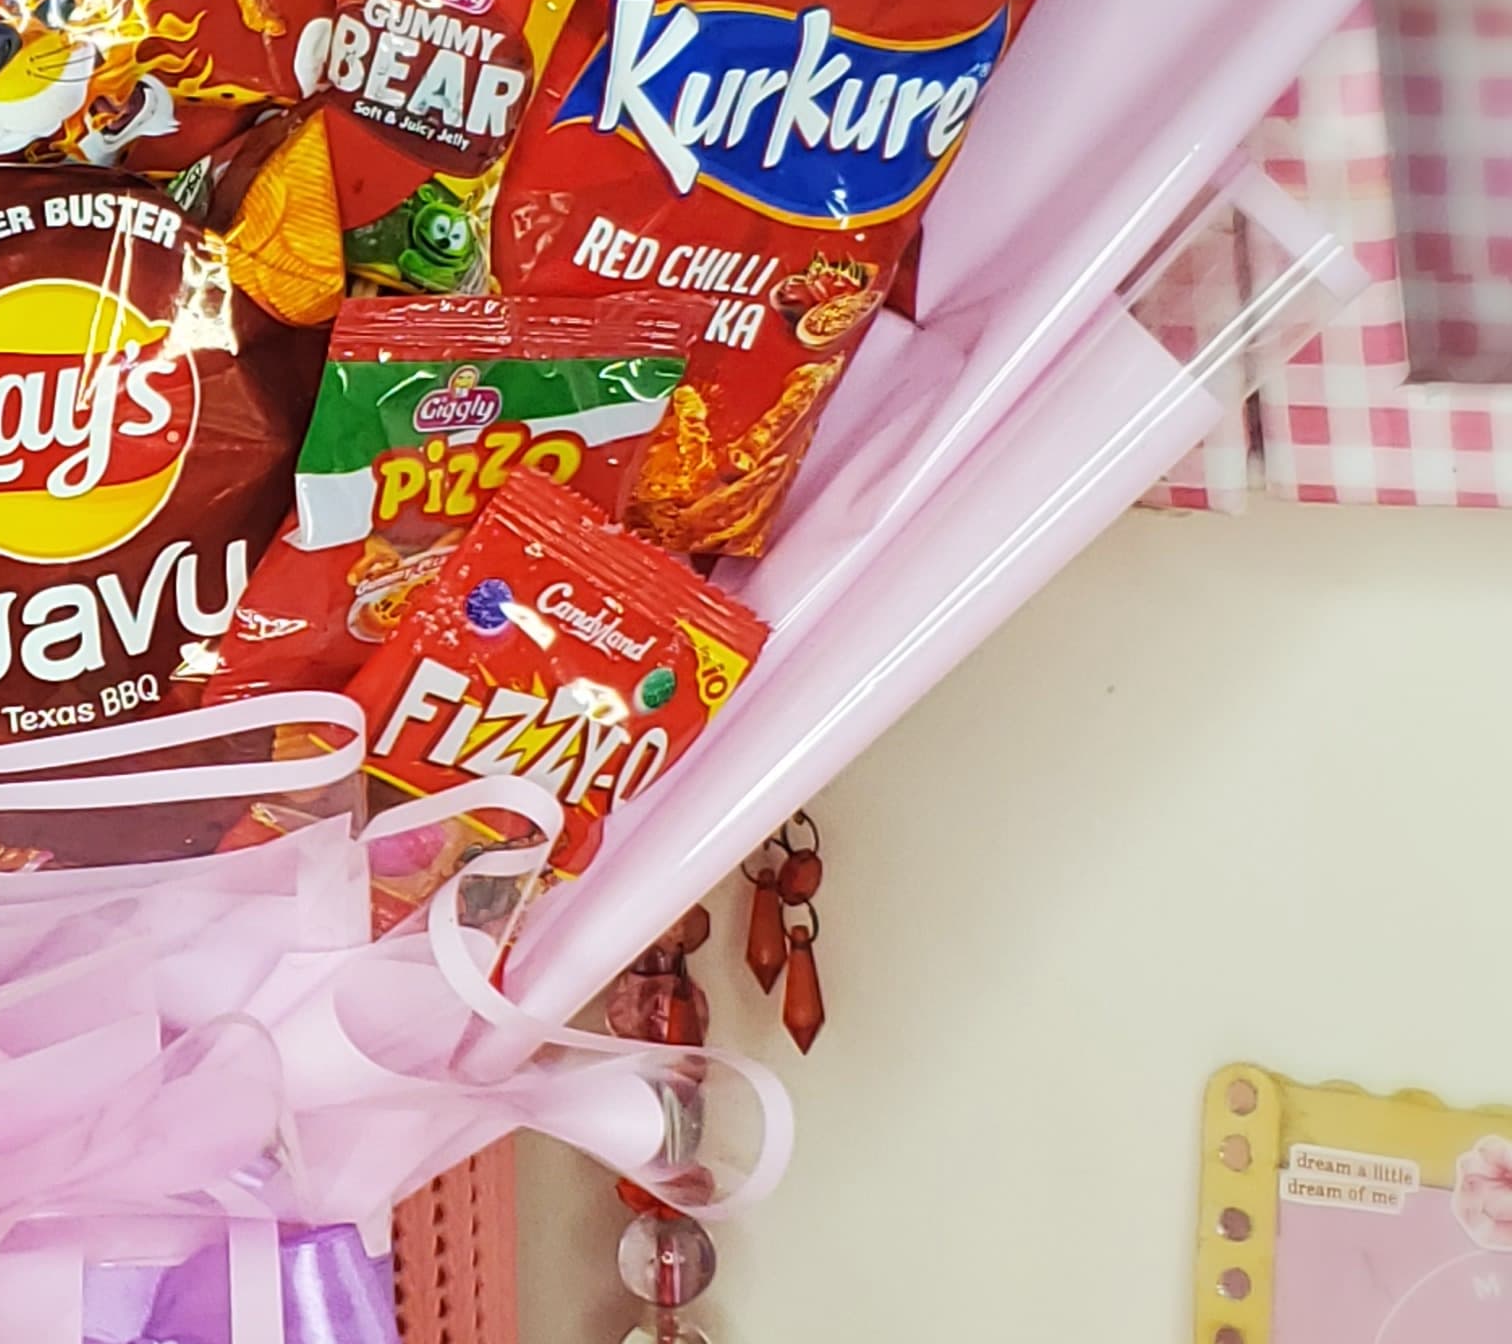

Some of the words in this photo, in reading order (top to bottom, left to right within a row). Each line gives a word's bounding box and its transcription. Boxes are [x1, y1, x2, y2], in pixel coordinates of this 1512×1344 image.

[328, 13, 525, 138] BEAR
[353, 101, 383, 123] Soft
[384, 111, 397, 126] &
[398, 117, 436, 141] Juicy
[436, 130, 470, 152] Jelly
[44, 194, 182, 250] BUSTER
[576, 218, 659, 284] RED
[659, 246, 777, 296] CHILLI
[420, 394, 495, 425] Giggly
[1, 701, 96, 735] Texas
[103, 674, 162, 719] BBQ
[1288, 1178, 1342, 1199] dream
[1349, 1186, 1366, 1201] of
[1372, 1191, 1398, 1205] me
[1296, 1152, 1351, 1176] dream
[1358, 1165, 1367, 1177] a
[1373, 1163, 1414, 1185] little
